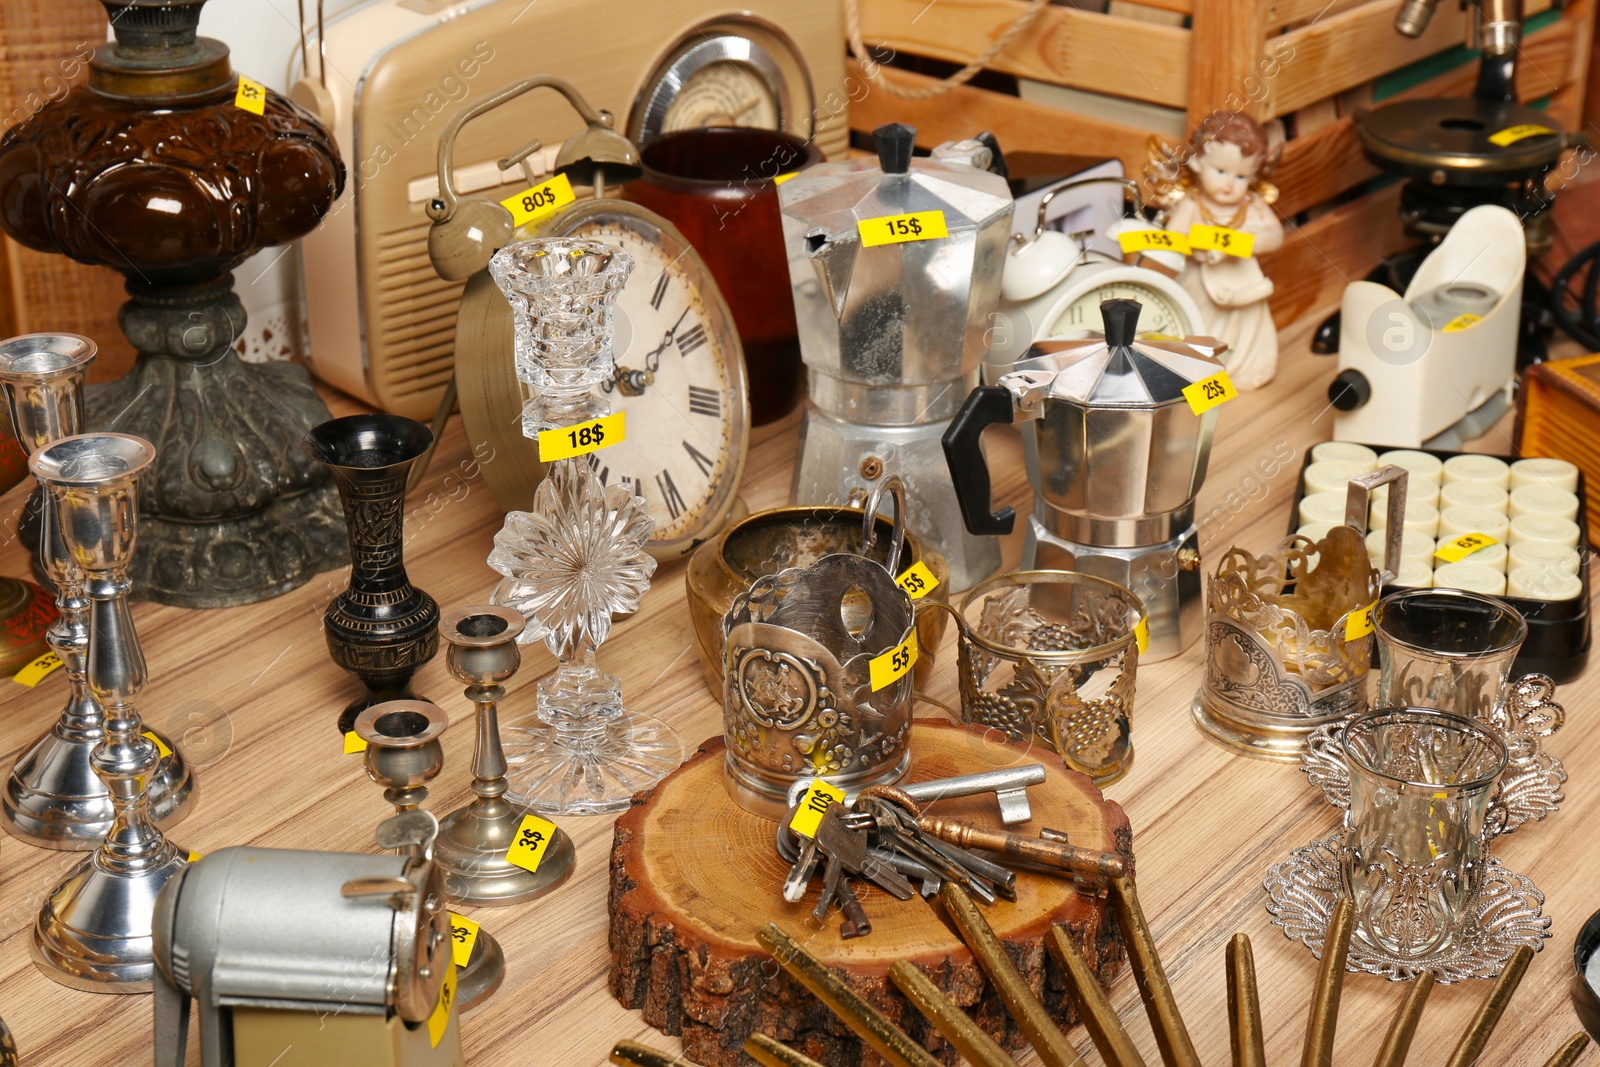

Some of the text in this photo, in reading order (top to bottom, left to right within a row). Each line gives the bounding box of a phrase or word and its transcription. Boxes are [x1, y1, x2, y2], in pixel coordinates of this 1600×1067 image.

[522, 186, 555, 212] 80$
[886, 217, 922, 236] 15$
[1143, 233, 1173, 247] 15$
[1213, 232, 1231, 248] 1$
[1203, 379, 1226, 400] 25$
[568, 423, 605, 448] 18$
[1457, 537, 1482, 549] 6$
[892, 646, 910, 671] 5$
[809, 789, 834, 814] 10$
[519, 828, 545, 851] 3$
[451, 925, 471, 943] 3$
